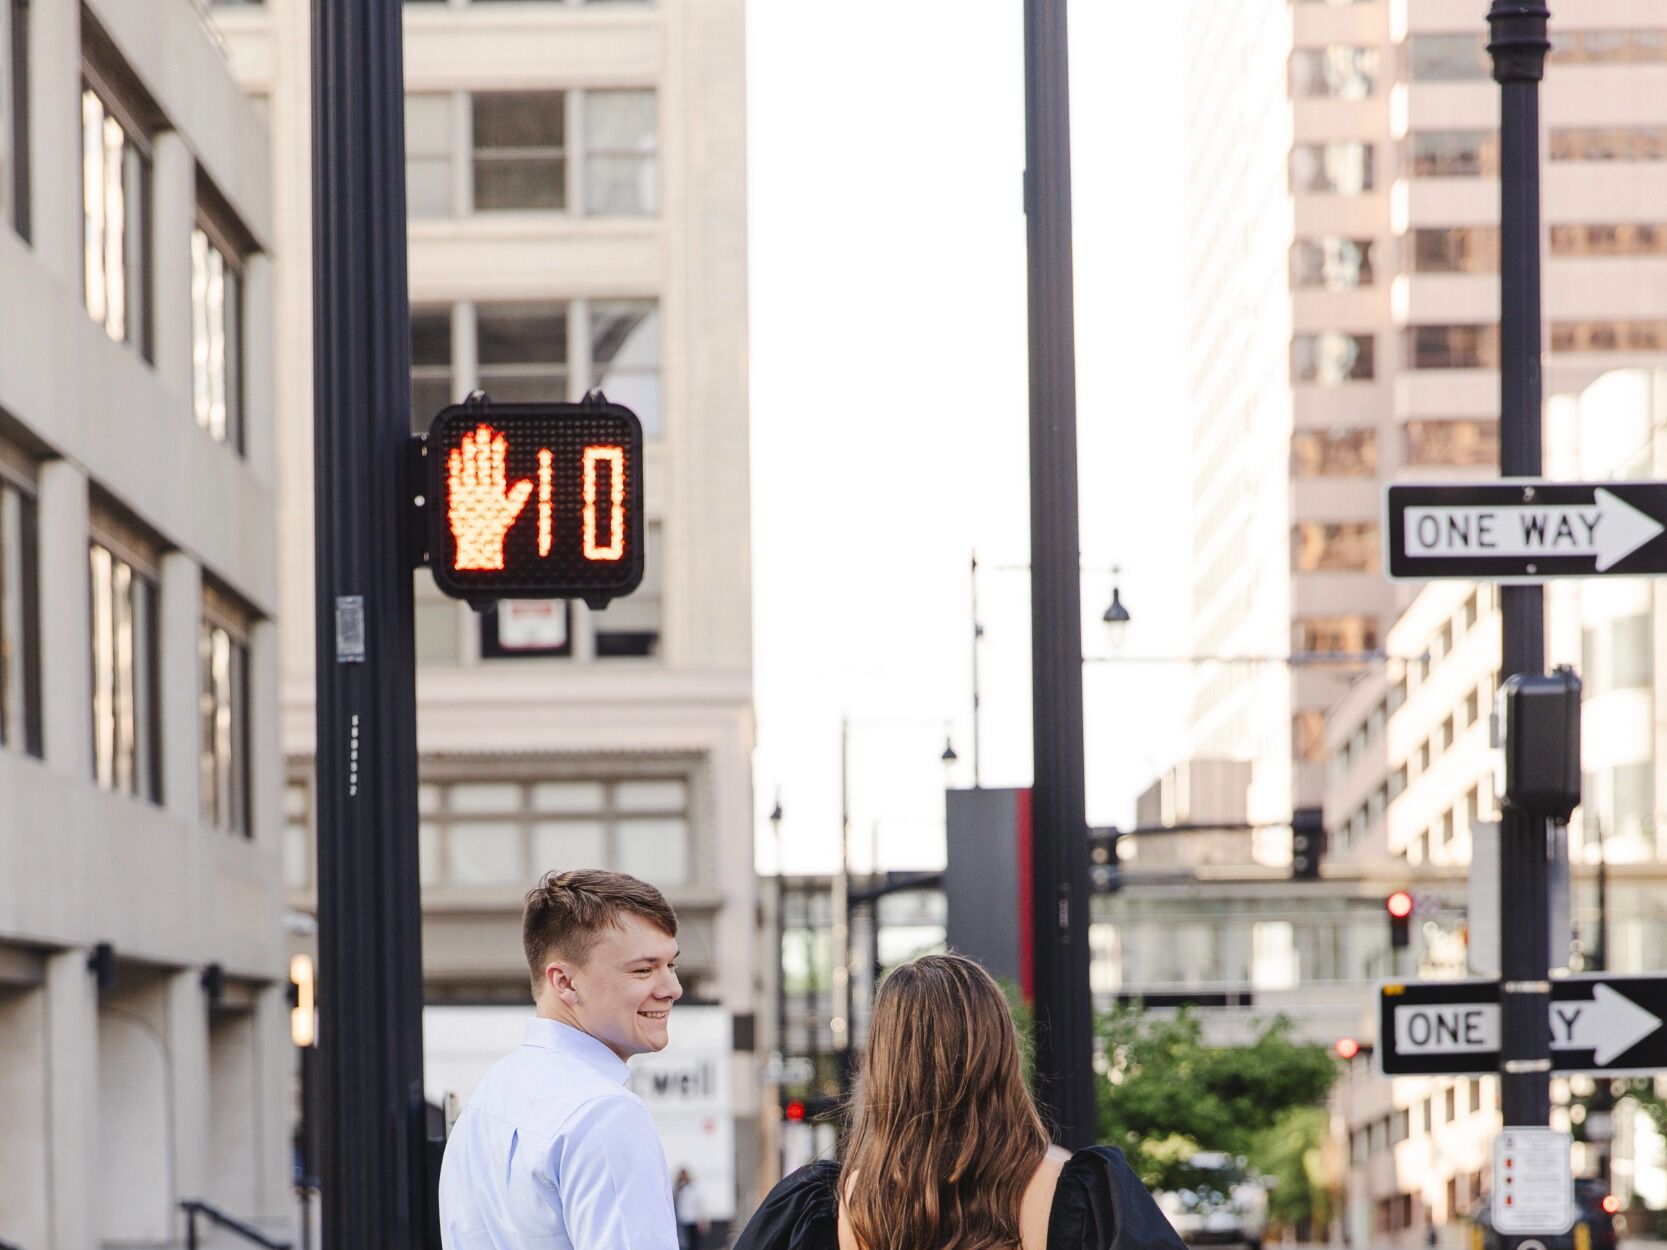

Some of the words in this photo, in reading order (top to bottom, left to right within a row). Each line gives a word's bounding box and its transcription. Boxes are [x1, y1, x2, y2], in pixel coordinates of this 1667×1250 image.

[538, 445, 625, 561] 10
[1417, 513, 1497, 549] ONE
[1520, 513, 1604, 548] WAY
[1408, 1010, 1485, 1046] ONE
